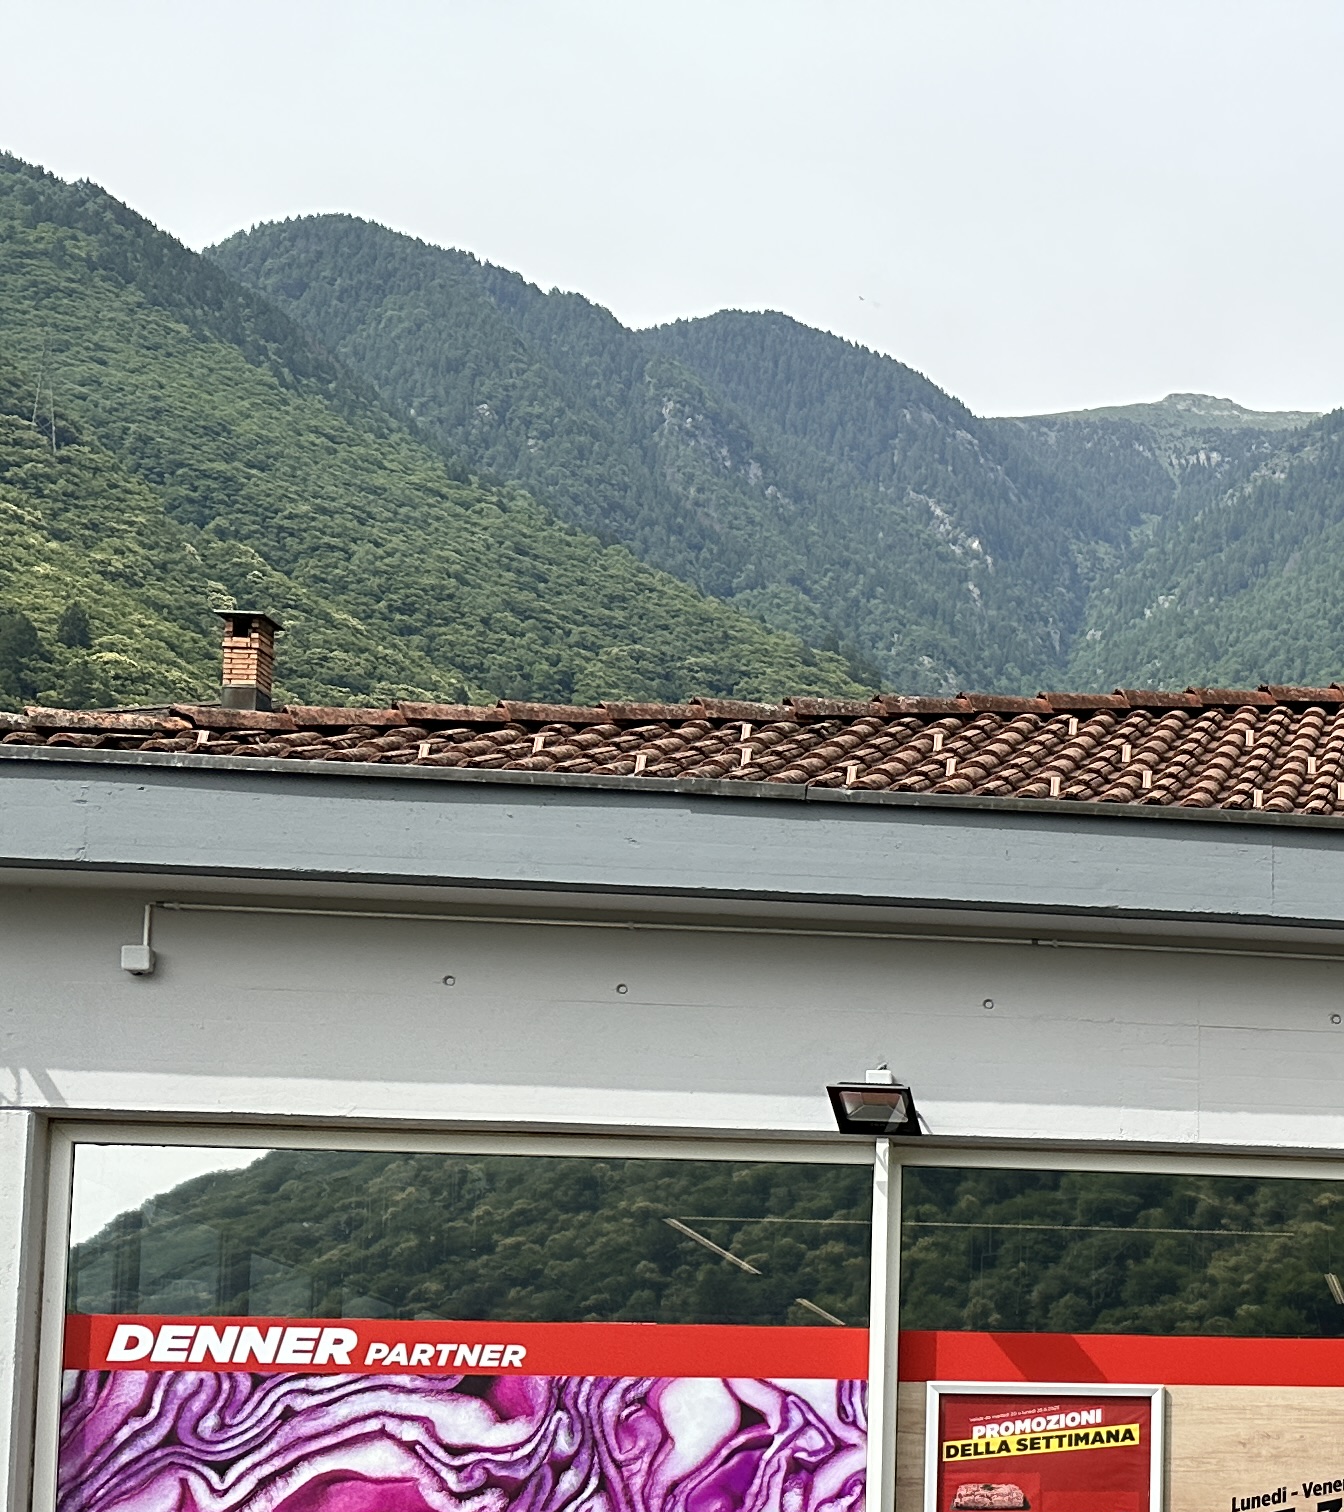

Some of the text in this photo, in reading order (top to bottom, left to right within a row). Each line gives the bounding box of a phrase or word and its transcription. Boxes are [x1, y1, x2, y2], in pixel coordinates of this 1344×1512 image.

[106, 1324, 527, 1368] DENNER PARTNER
[972, 1408, 1103, 1440] PROMOZIONI
[945, 1428, 1136, 1459] DELLA SETTIMANA
